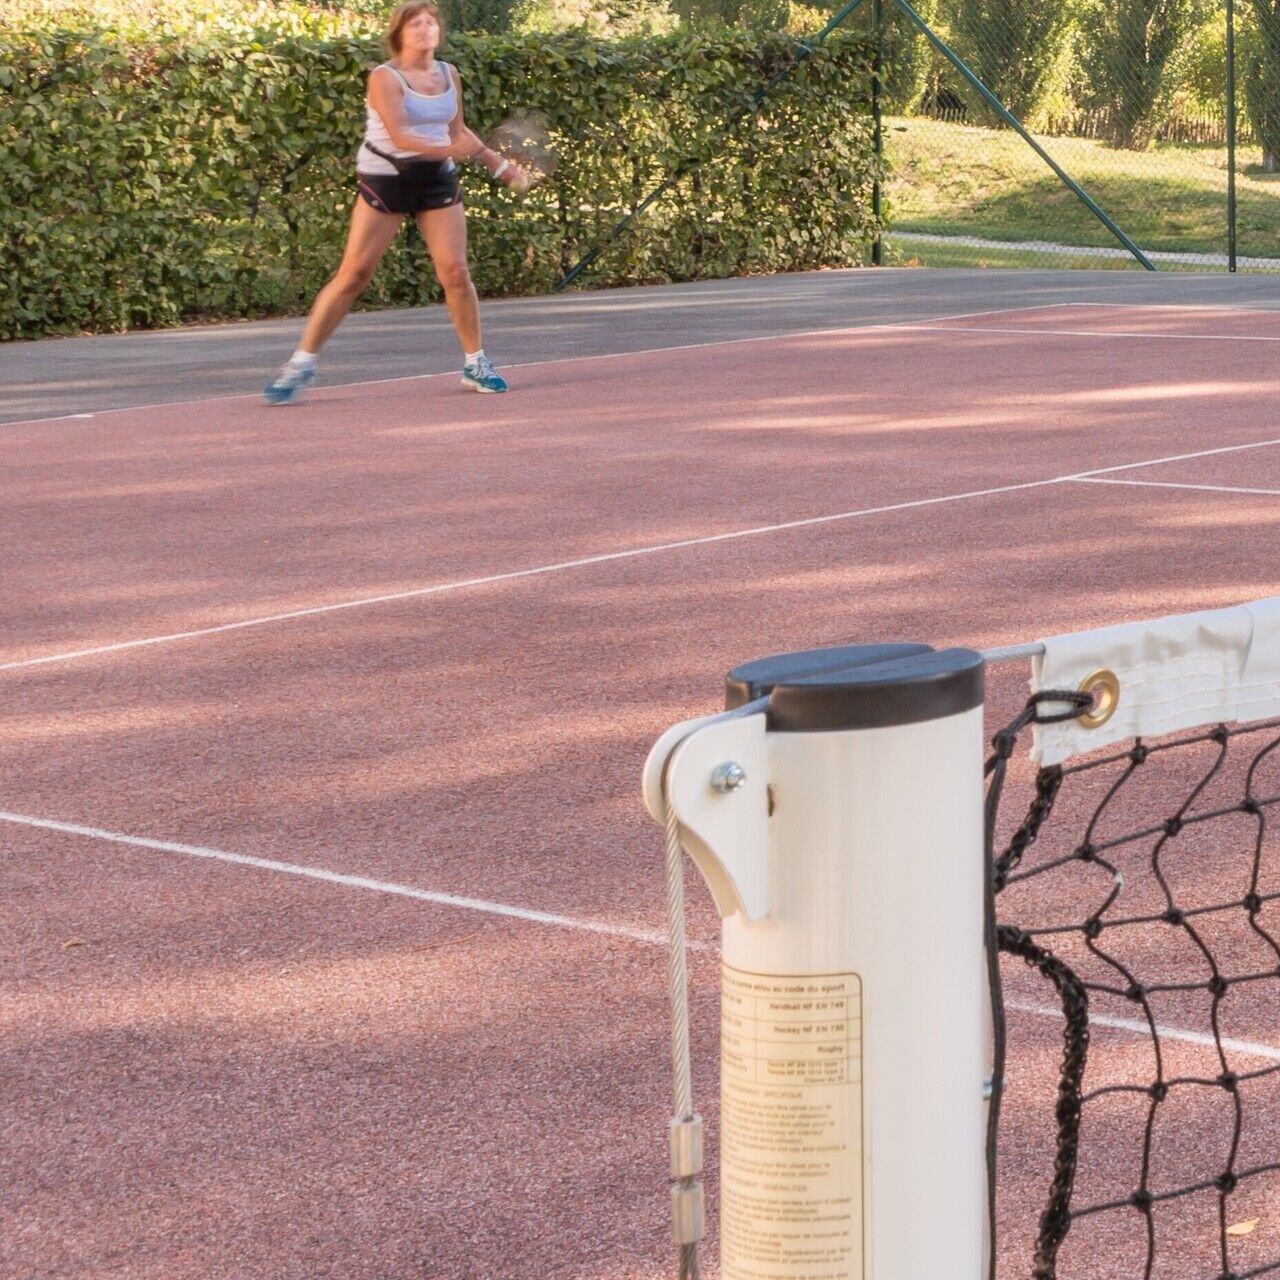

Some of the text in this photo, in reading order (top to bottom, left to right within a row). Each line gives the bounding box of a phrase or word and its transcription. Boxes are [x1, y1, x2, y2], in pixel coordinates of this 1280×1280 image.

[784, 984, 805, 993] code
[807, 984, 819, 993] du
[821, 983, 846, 994] sport
[769, 1002, 801, 1011] Handball
[802, 1002, 813, 1010] NF
[816, 1002, 828, 1010] EN
[774, 1026, 801, 1035] Hockey
[817, 1045, 844, 1055] Rugby
